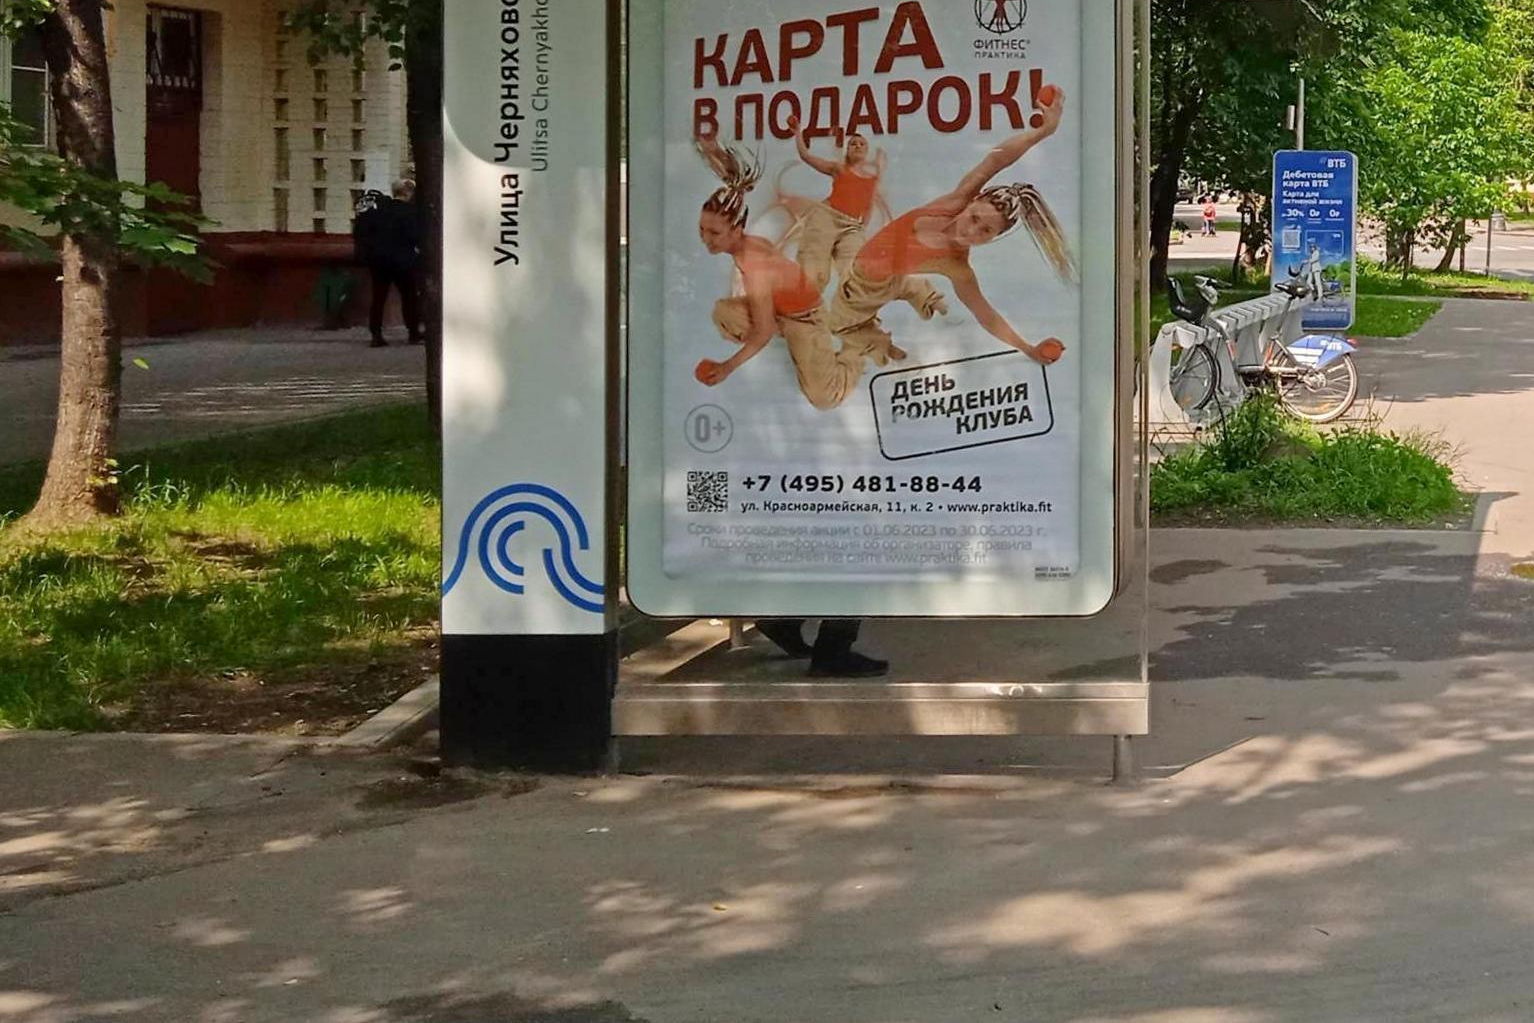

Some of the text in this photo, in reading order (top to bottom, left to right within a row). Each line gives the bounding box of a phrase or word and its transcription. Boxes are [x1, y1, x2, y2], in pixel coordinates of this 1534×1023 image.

[693, 0, 944, 89] КАРТА
[974, 51, 1026, 59] ПРАКТИКА
[693, 68, 1044, 148] В ПОДАРОК!
[531, 118, 548, 173] Ulitsa
[1327, 158, 1347, 168] ВТБ
[494, 173, 523, 266] Улица
[890, 374, 956, 404] ДЕНЬ
[892, 382, 1029, 423] РОЖДЕНИЯ
[694, 413, 727, 444] 0+
[956, 405, 1034, 434] КЛУБА
[742, 474, 982, 493] +7 (495) 481-88-44
[741, 500, 1053, 515] ул. Красноармейская, 11, к. 2 www.praktika.fit
